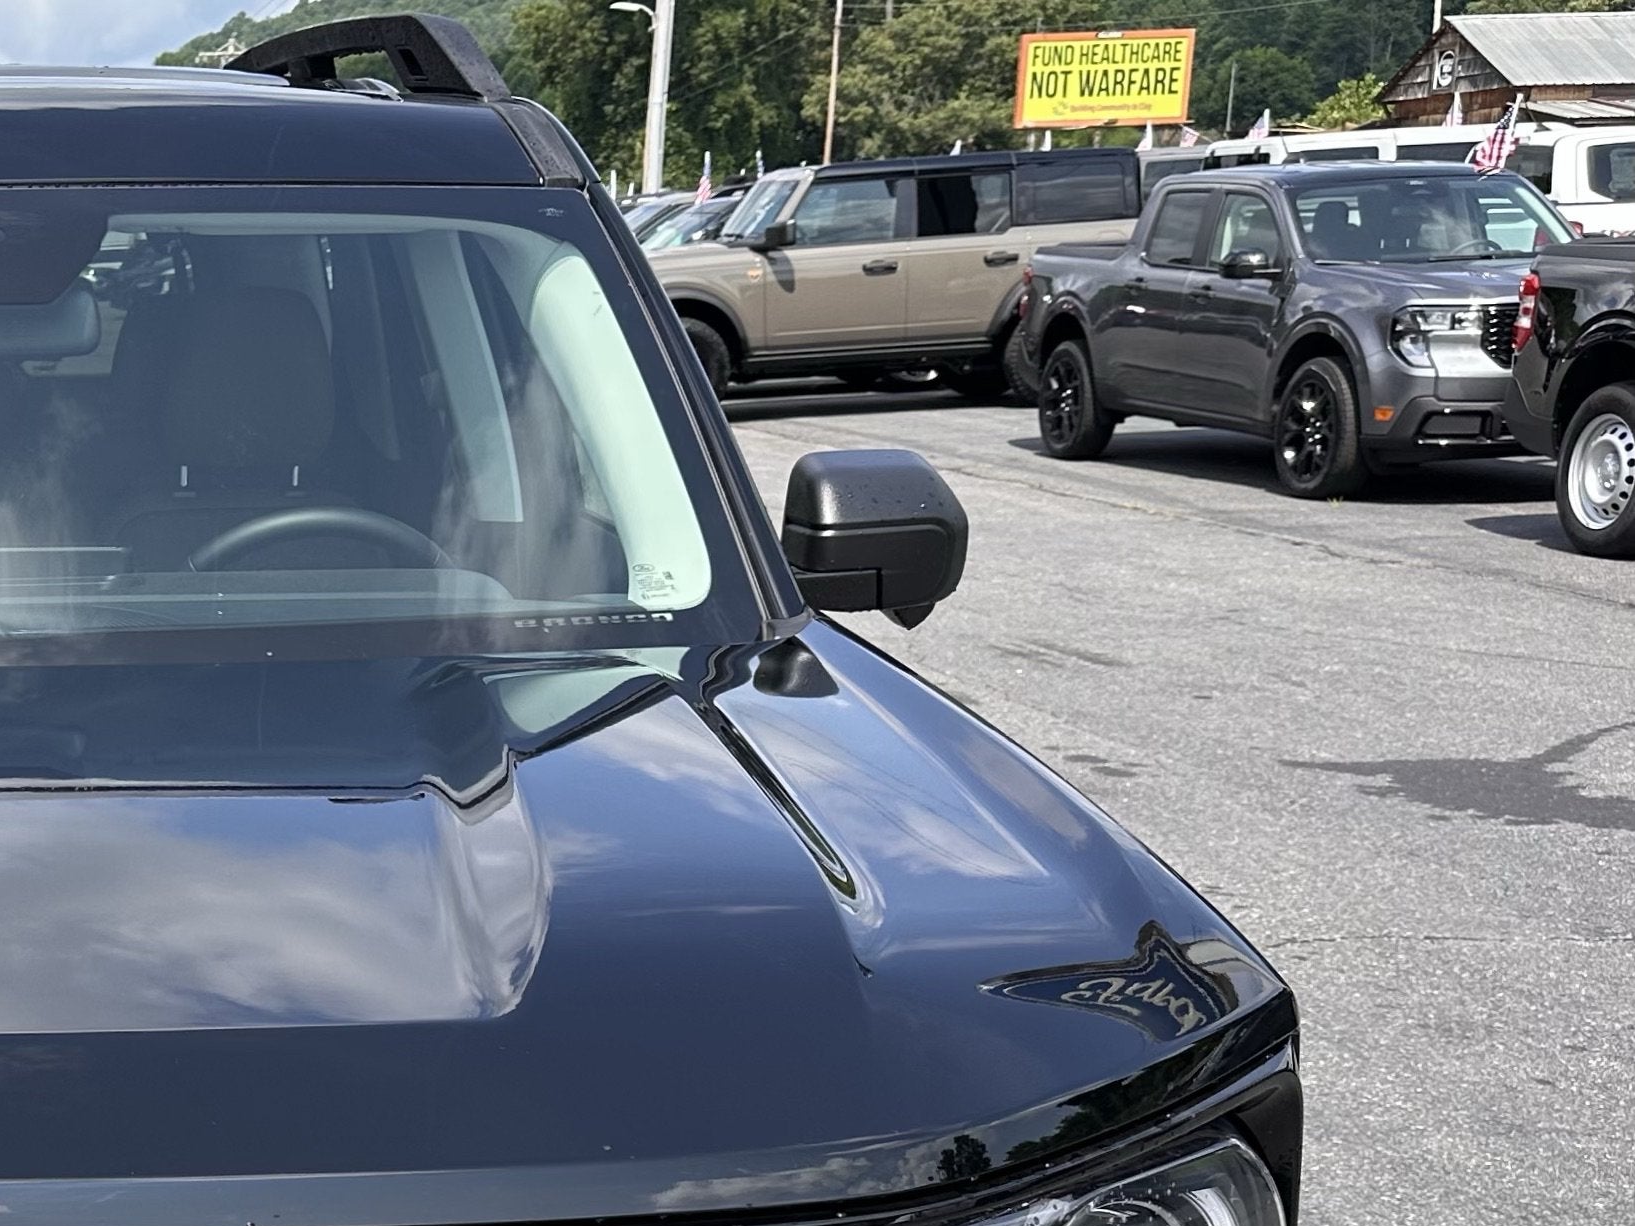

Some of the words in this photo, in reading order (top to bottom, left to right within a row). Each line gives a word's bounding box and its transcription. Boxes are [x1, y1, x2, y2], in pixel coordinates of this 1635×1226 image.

[1032, 45, 1075, 67] FUND
[1079, 41, 1183, 65] HEALTHCARE
[1030, 70, 1073, 99] NOT
[1079, 67, 1181, 97] WARFARE
